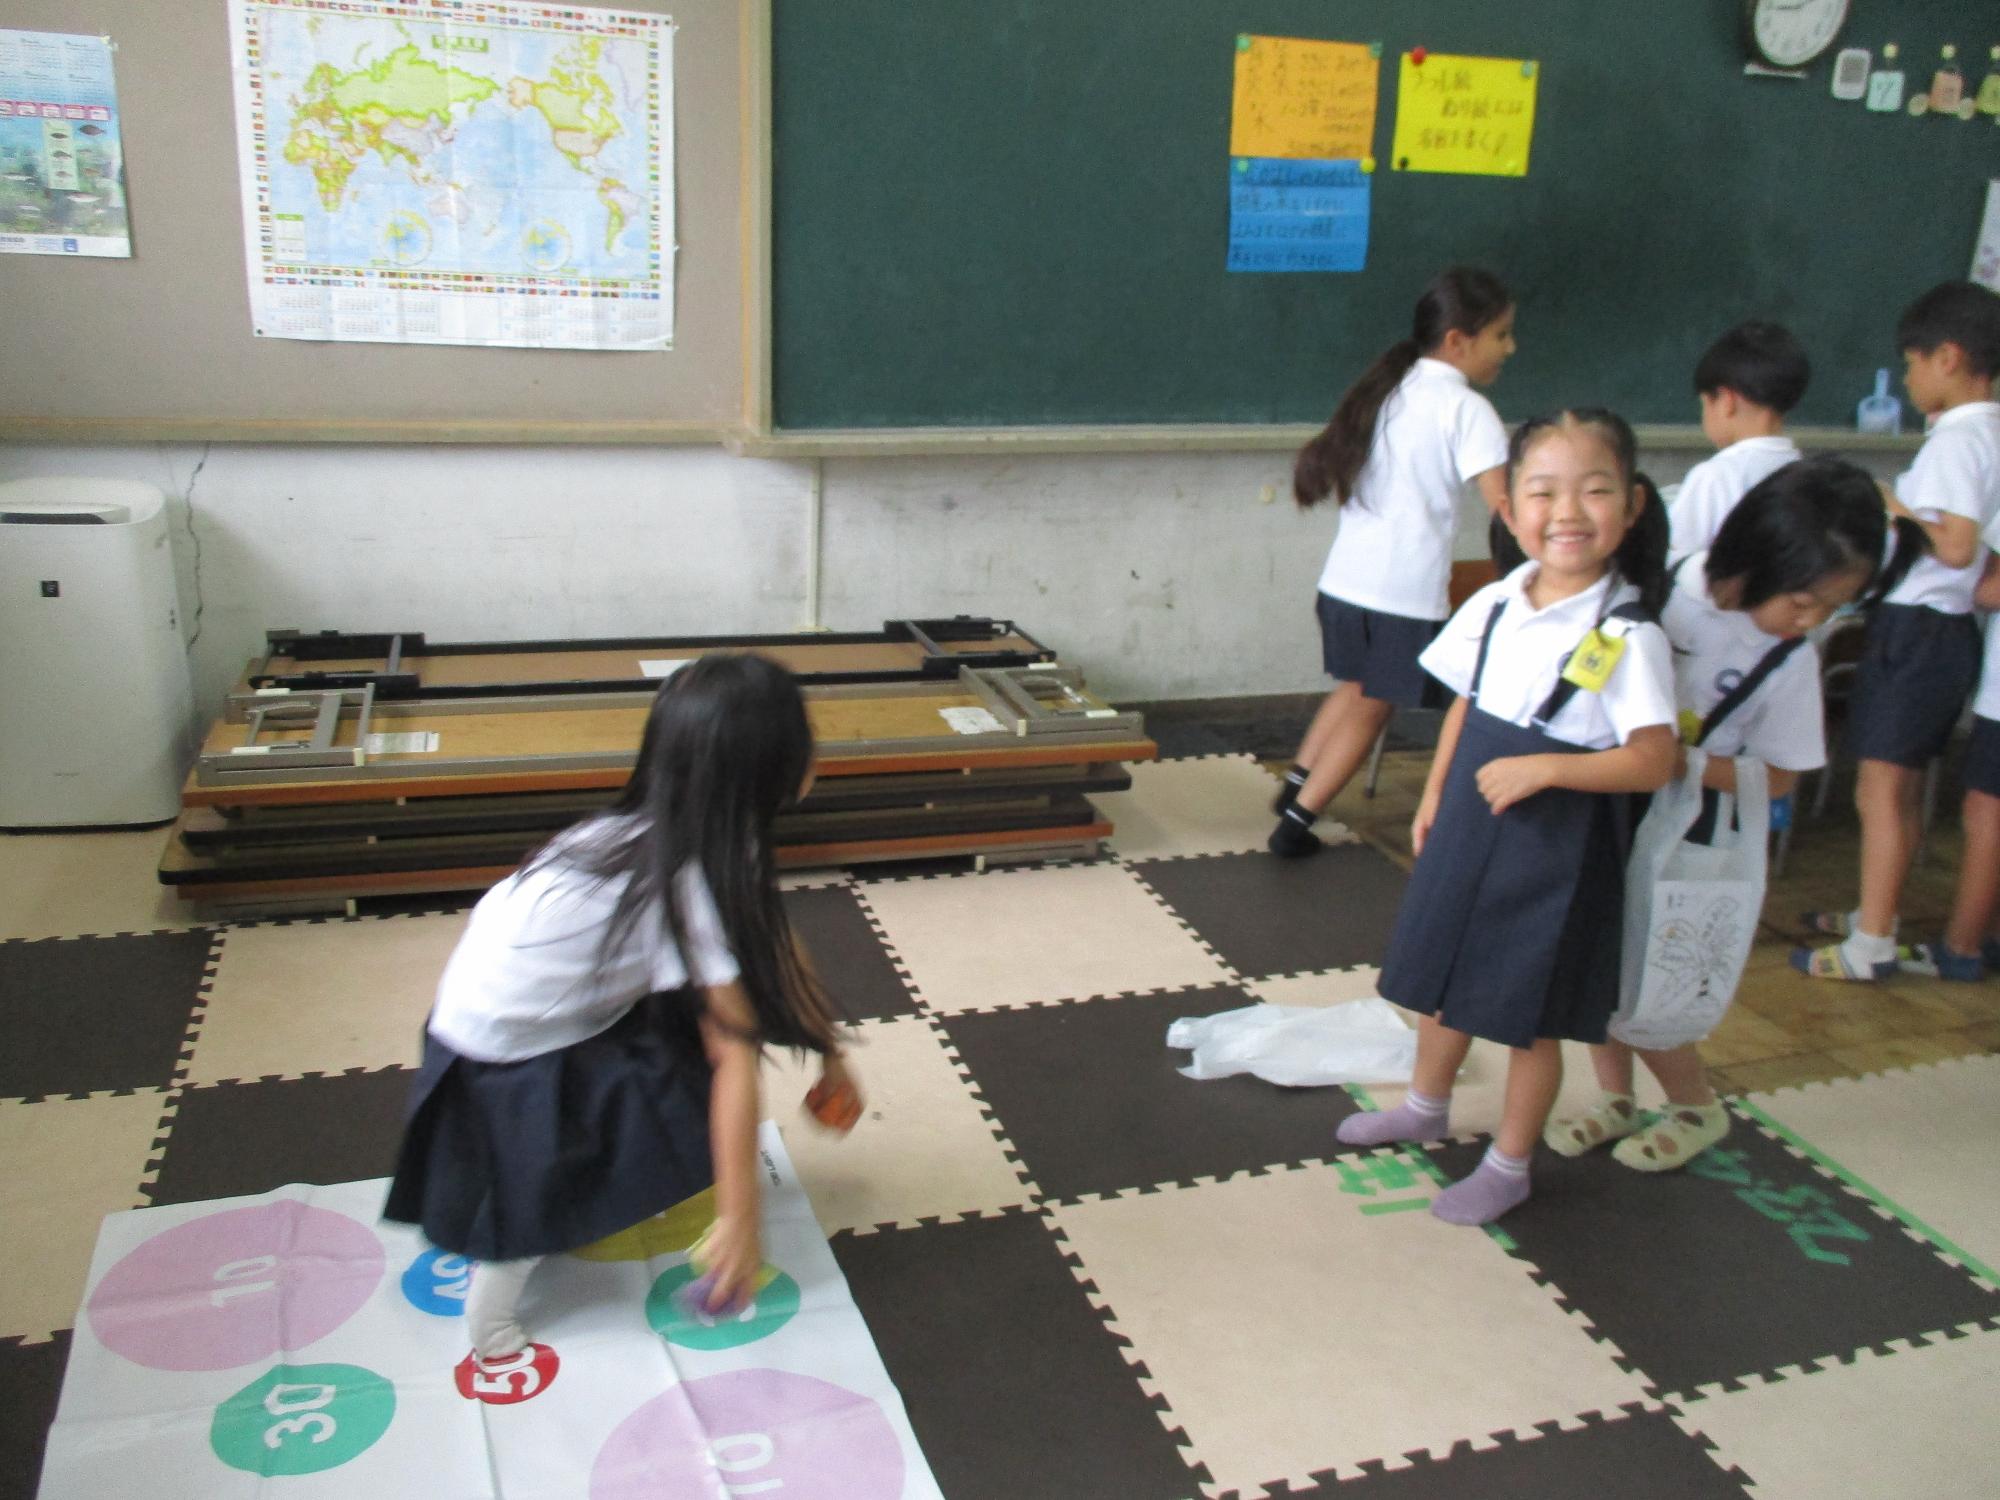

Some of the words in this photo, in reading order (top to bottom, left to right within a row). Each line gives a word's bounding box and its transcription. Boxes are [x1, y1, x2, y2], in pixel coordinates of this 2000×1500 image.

[209, 1254, 280, 1309] 10
[471, 1345, 541, 1396] 50
[262, 1383, 337, 1450] 30
[704, 1431, 784, 1500] 10
